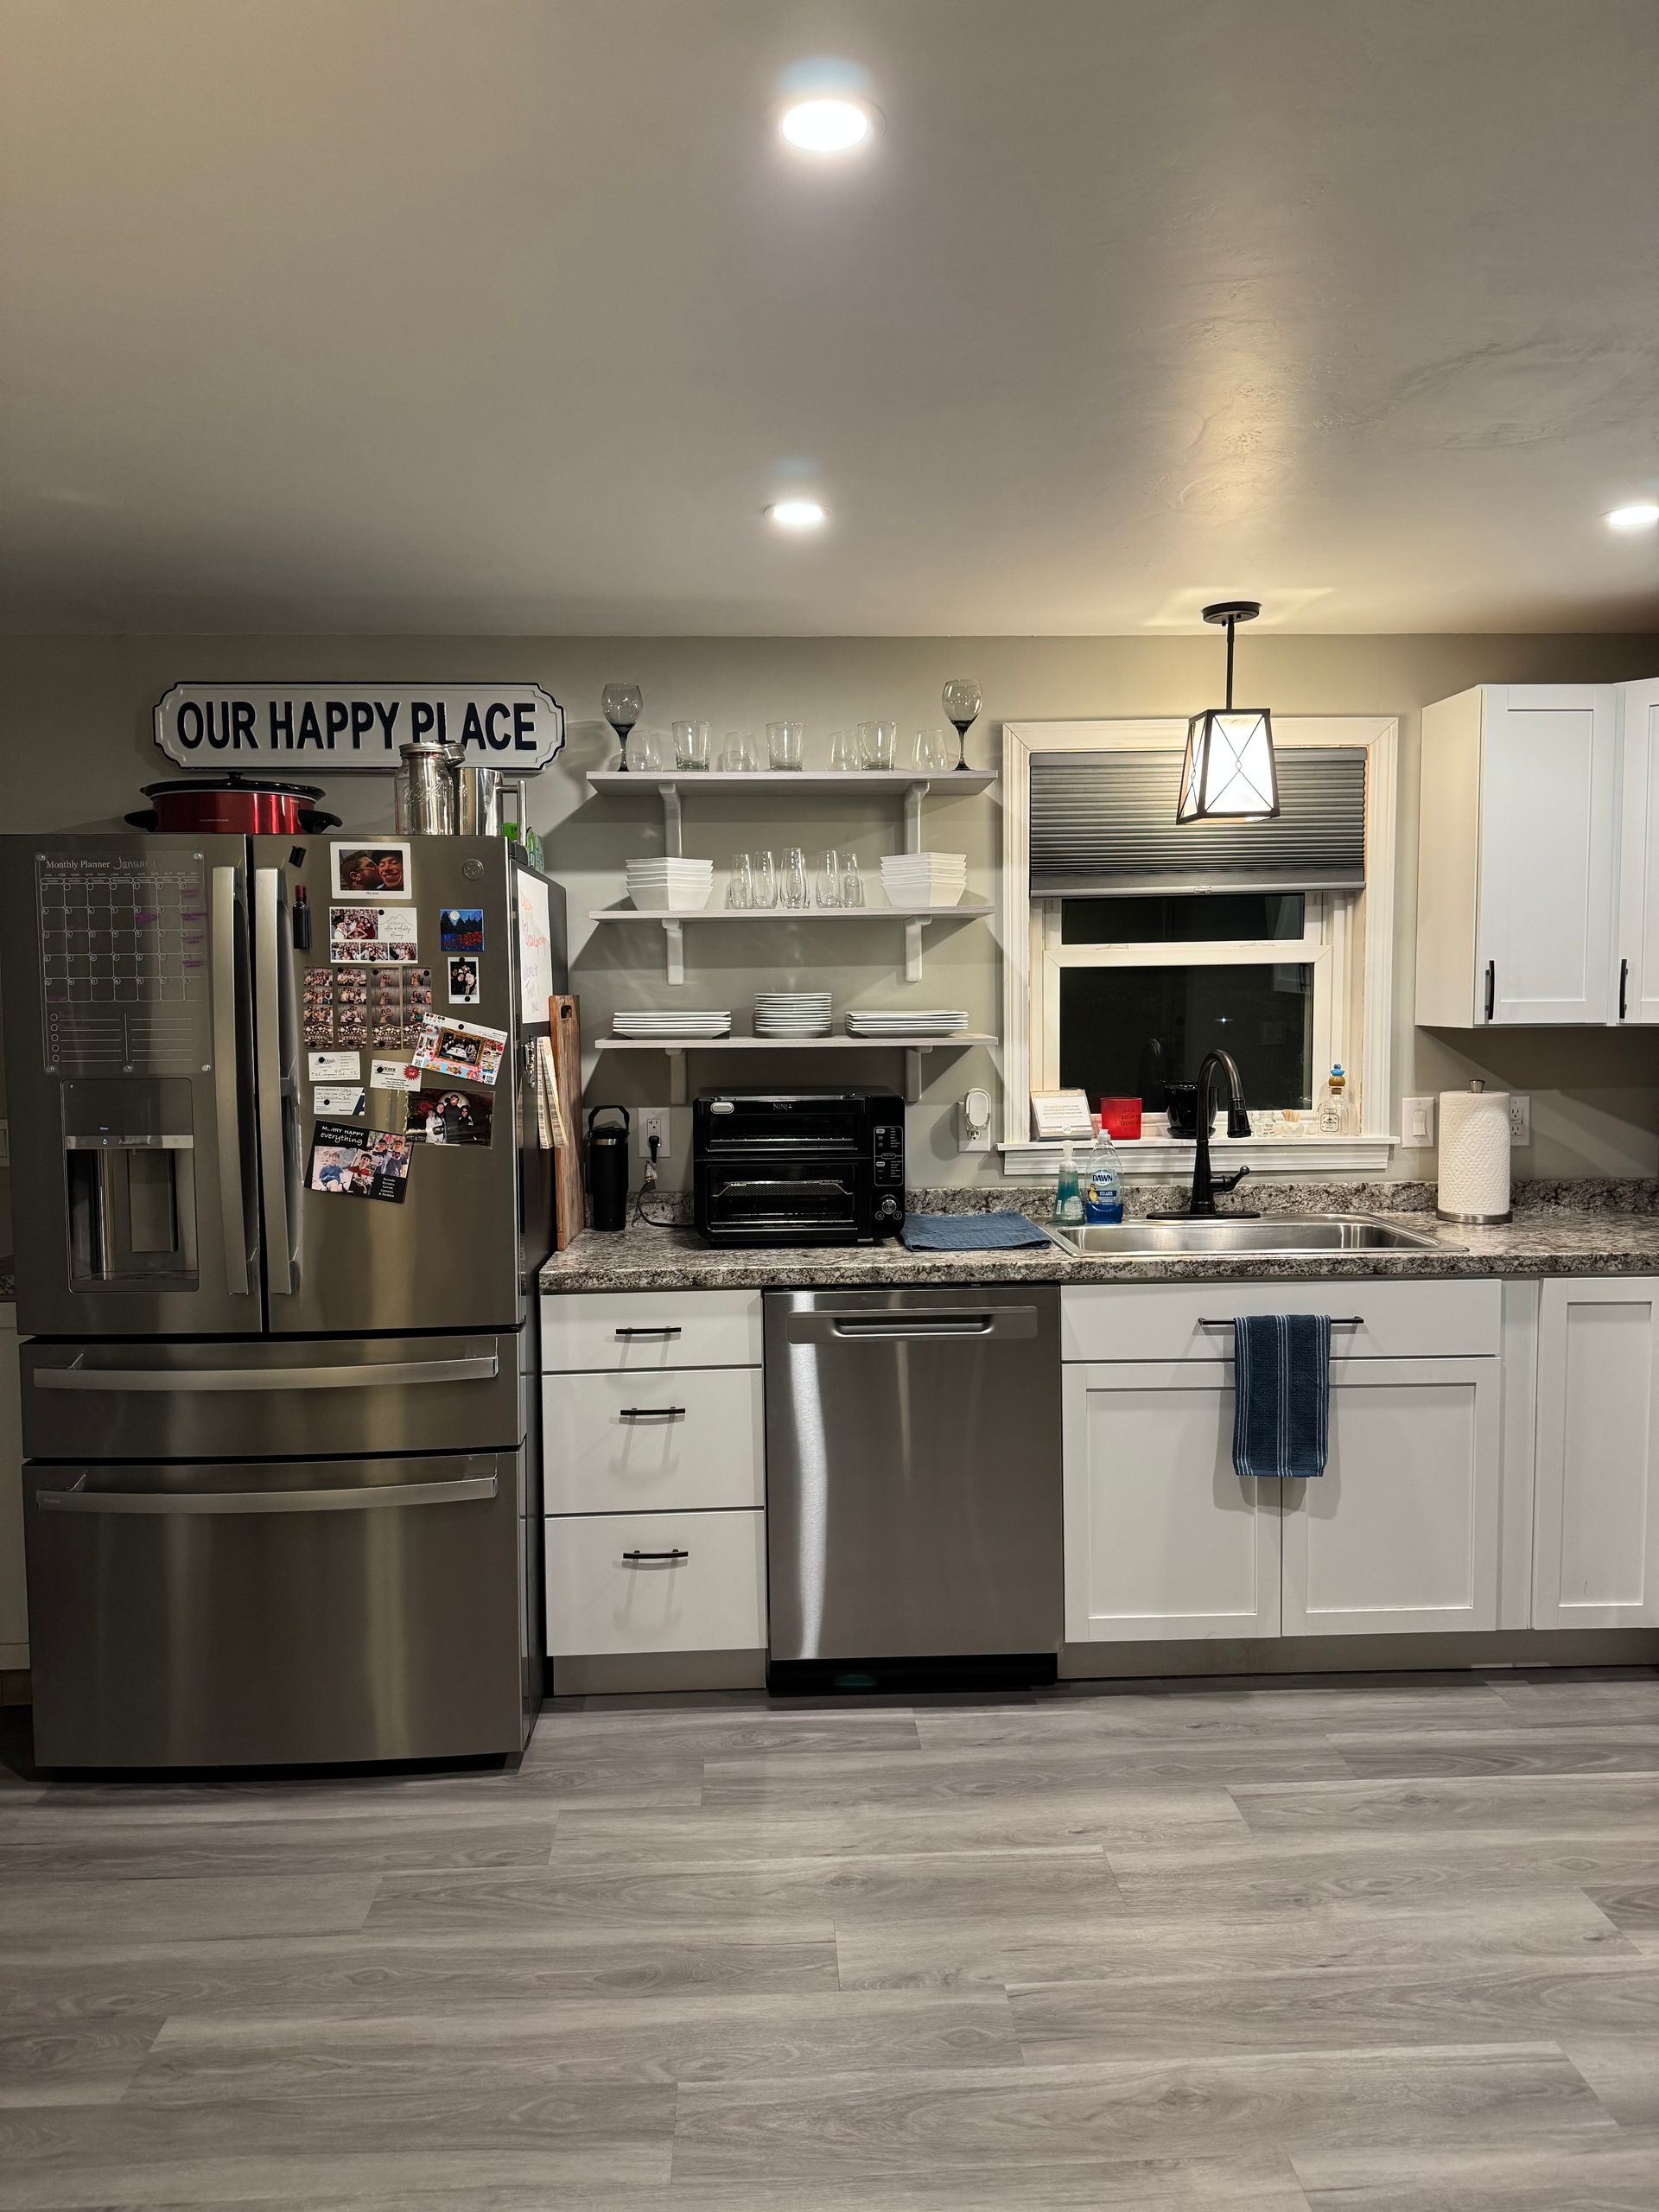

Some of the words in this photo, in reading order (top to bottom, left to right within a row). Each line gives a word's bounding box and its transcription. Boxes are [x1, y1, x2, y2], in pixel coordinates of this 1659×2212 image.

[177, 701, 259, 749] OUR
[270, 701, 400, 749] HAPPY
[411, 702, 537, 750] PLACE
[46, 859, 78, 870] Monthly
[80, 859, 110, 869] Planner
[772, 1102, 793, 1112] NINJA
[320, 1132, 363, 1147] everything
